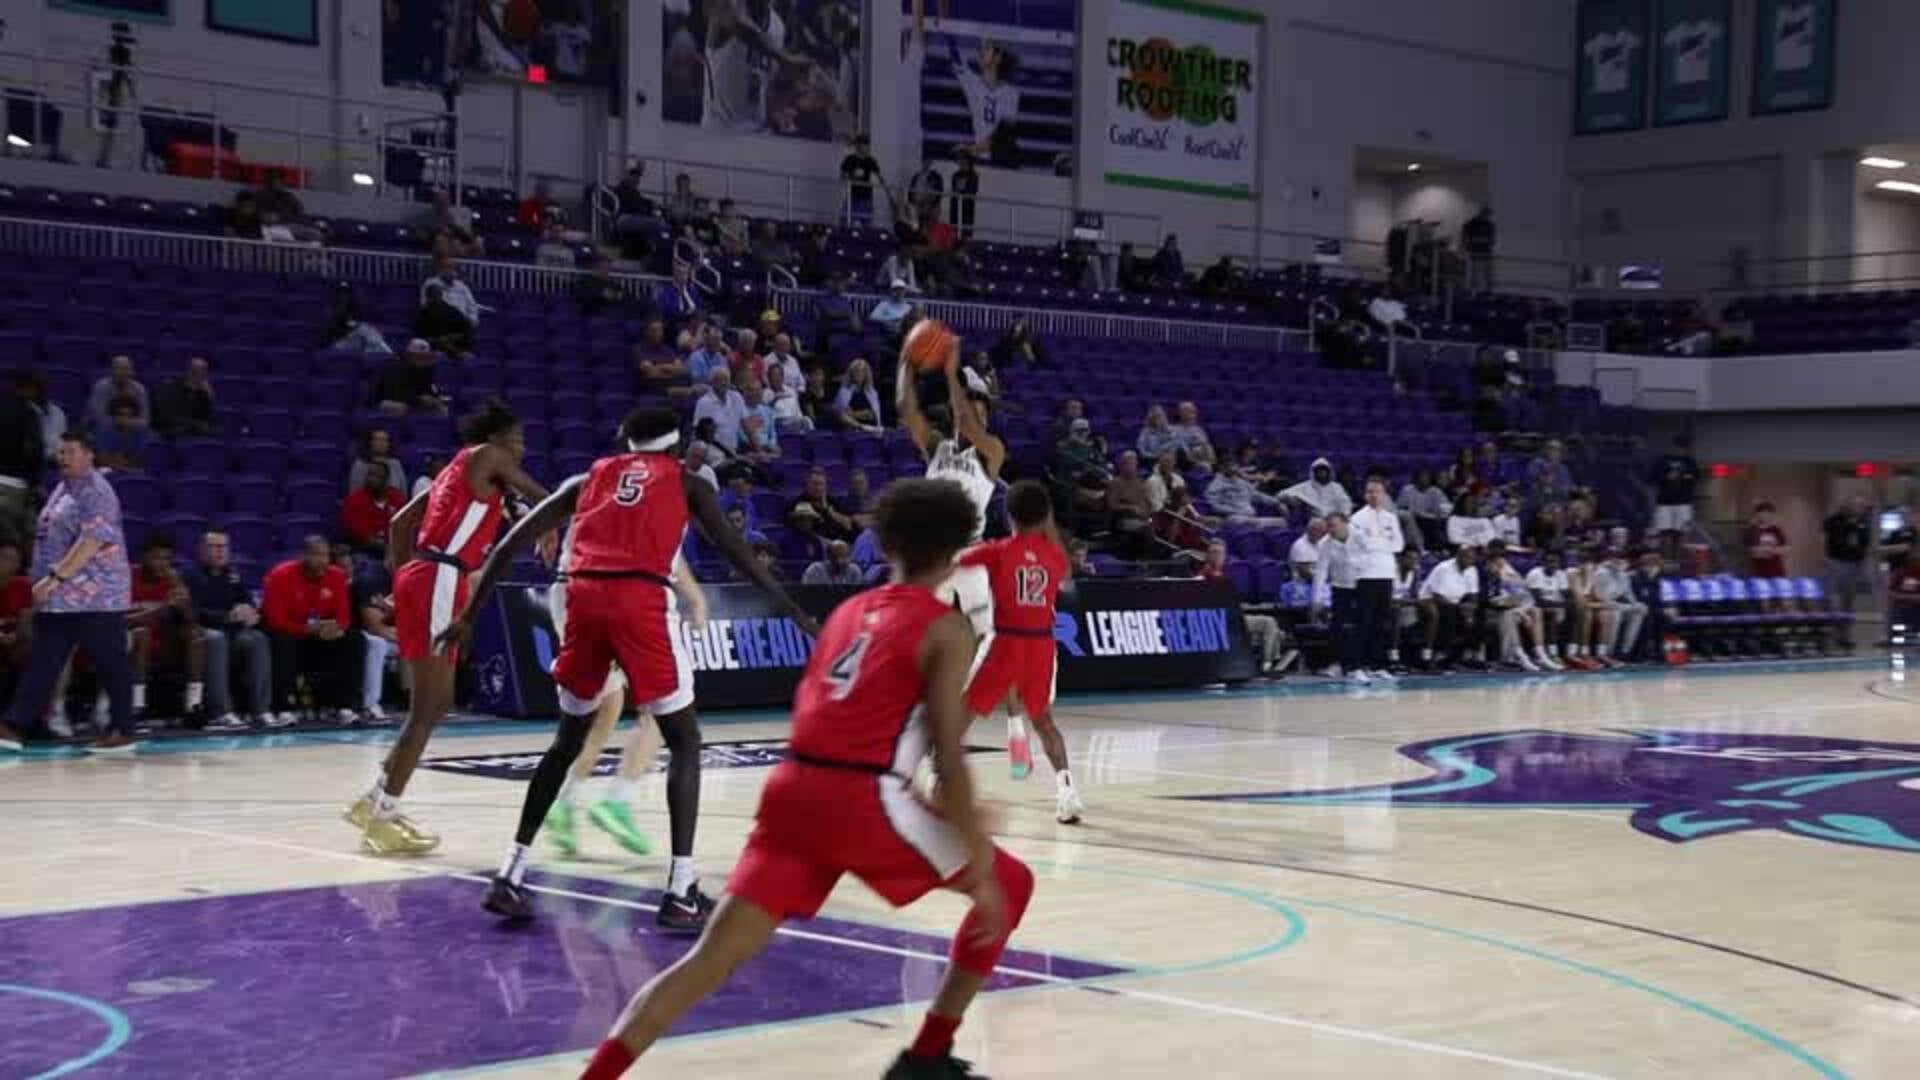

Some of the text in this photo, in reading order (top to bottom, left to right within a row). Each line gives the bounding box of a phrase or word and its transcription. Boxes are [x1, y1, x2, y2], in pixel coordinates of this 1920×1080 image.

[1107, 38, 1252, 91] CROWTHER
[1118, 77, 1237, 123] ROOFING
[612, 469, 650, 507] 5
[1015, 564, 1049, 608] 12
[824, 631, 873, 700] 4
